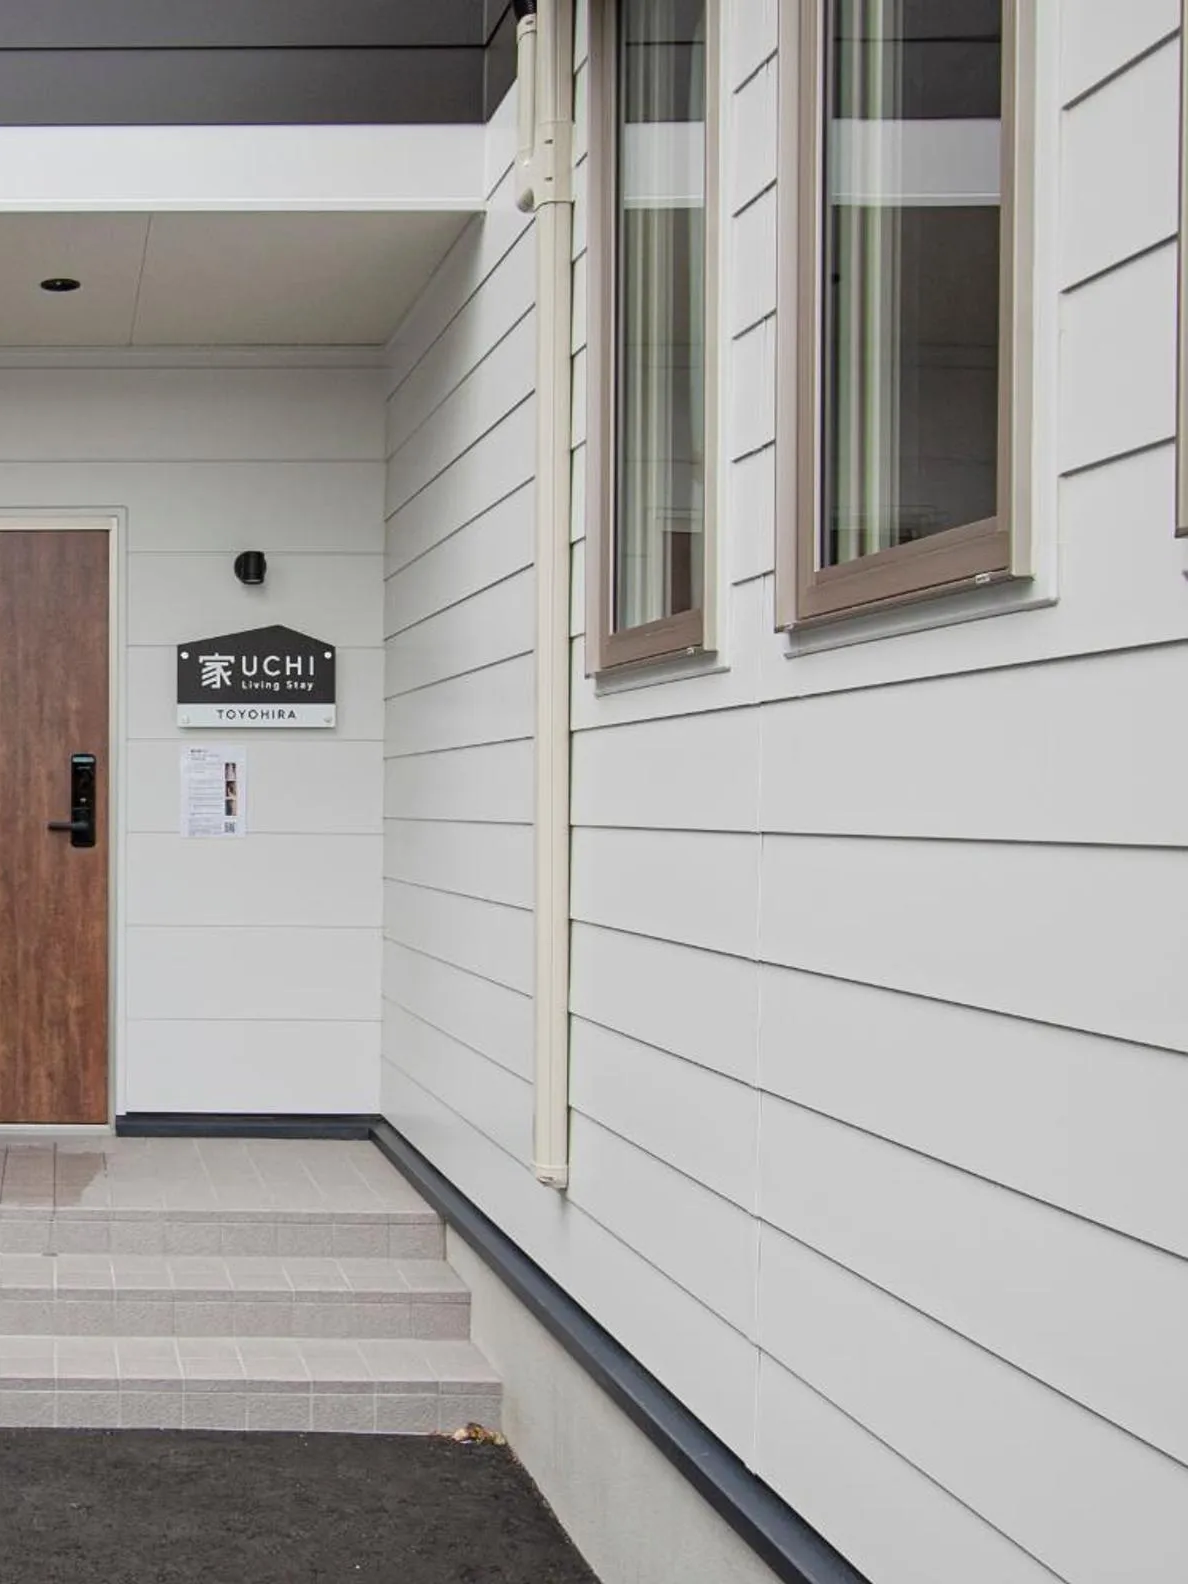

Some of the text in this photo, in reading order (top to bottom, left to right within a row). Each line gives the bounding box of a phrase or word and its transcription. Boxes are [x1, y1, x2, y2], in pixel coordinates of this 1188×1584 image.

[198, 652, 315, 689] 家 UCHI
[241, 680, 314, 691] Living Stay
[216, 709, 297, 720] TOYOHIRA
